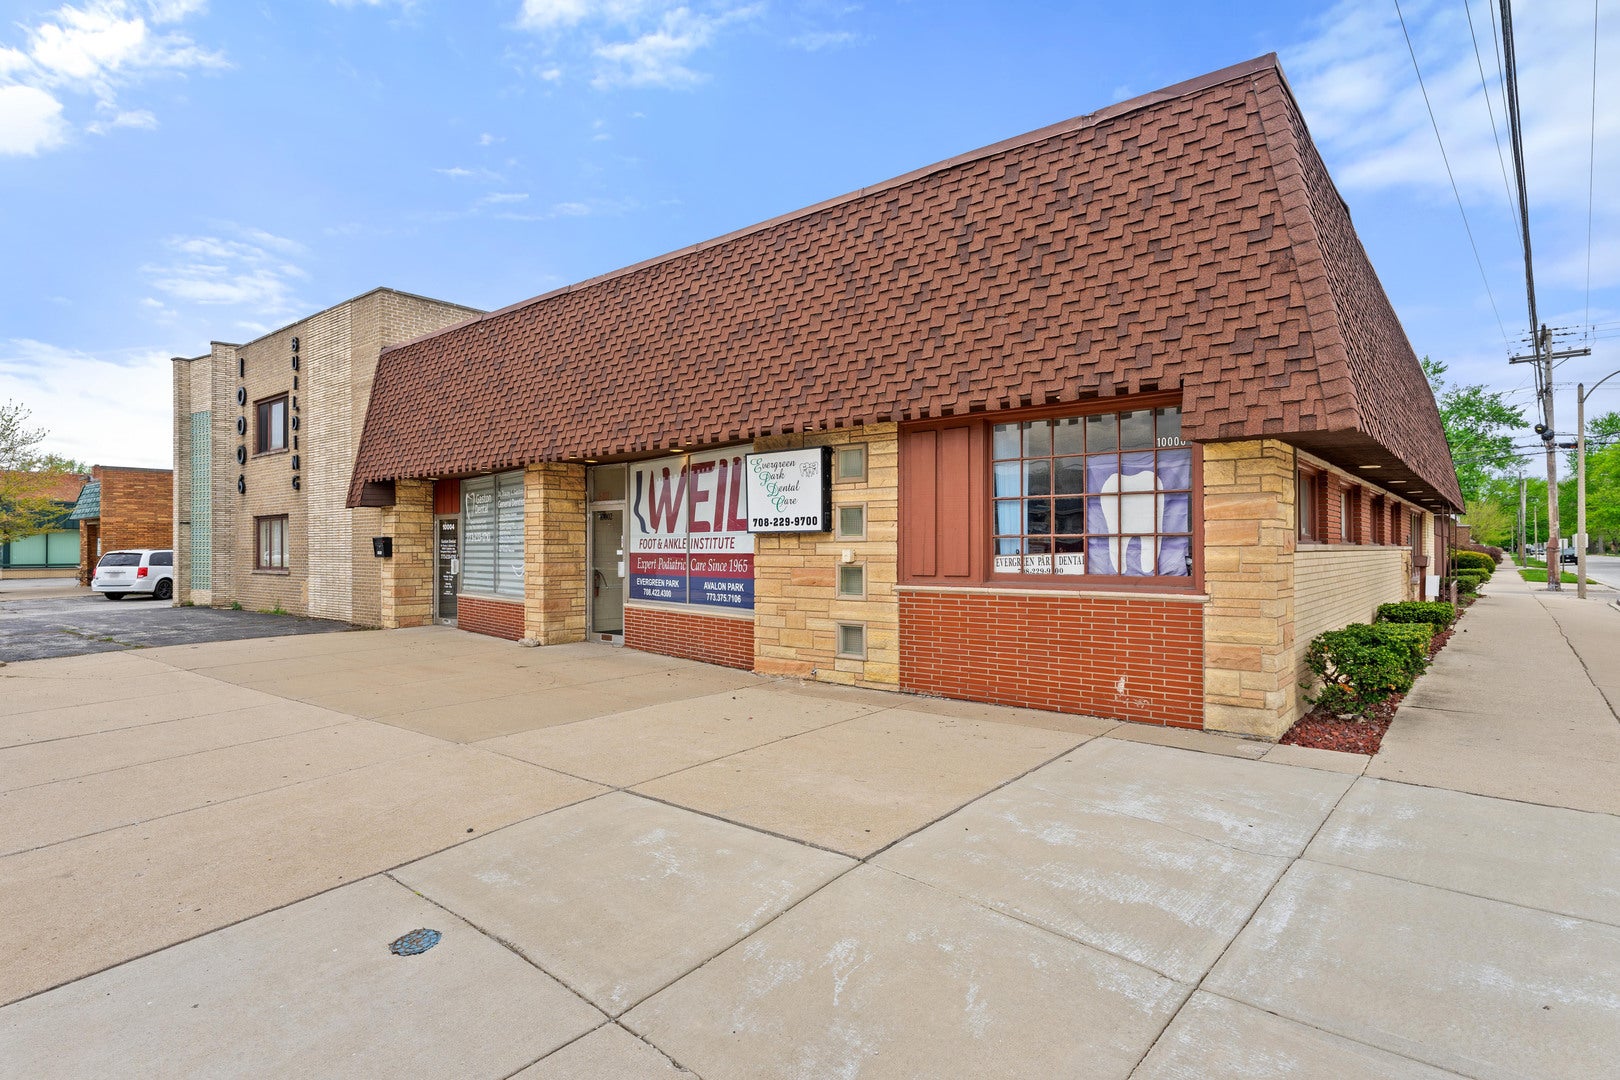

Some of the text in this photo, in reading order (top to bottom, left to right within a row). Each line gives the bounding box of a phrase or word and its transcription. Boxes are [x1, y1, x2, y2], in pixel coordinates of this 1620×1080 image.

[237, 357, 247, 494] 10006
[750, 458, 796, 473] Evergreen
[759, 468, 785, 486] Park
[649, 457, 747, 533] WEIL
[766, 480, 800, 497] Dental
[771, 495, 797, 512] Care
[753, 516, 818, 527] 708-229-9700
[639, 537, 735, 550] FOOT & ANKLE INSTITUTE
[637, 557, 748, 573] Expert Podiatric Care Since 1965
[1038, 556, 1052, 566] PAR
[636, 578, 680, 588] EVERGREEN PARK
[704, 582, 744, 592] AVALON PARK
